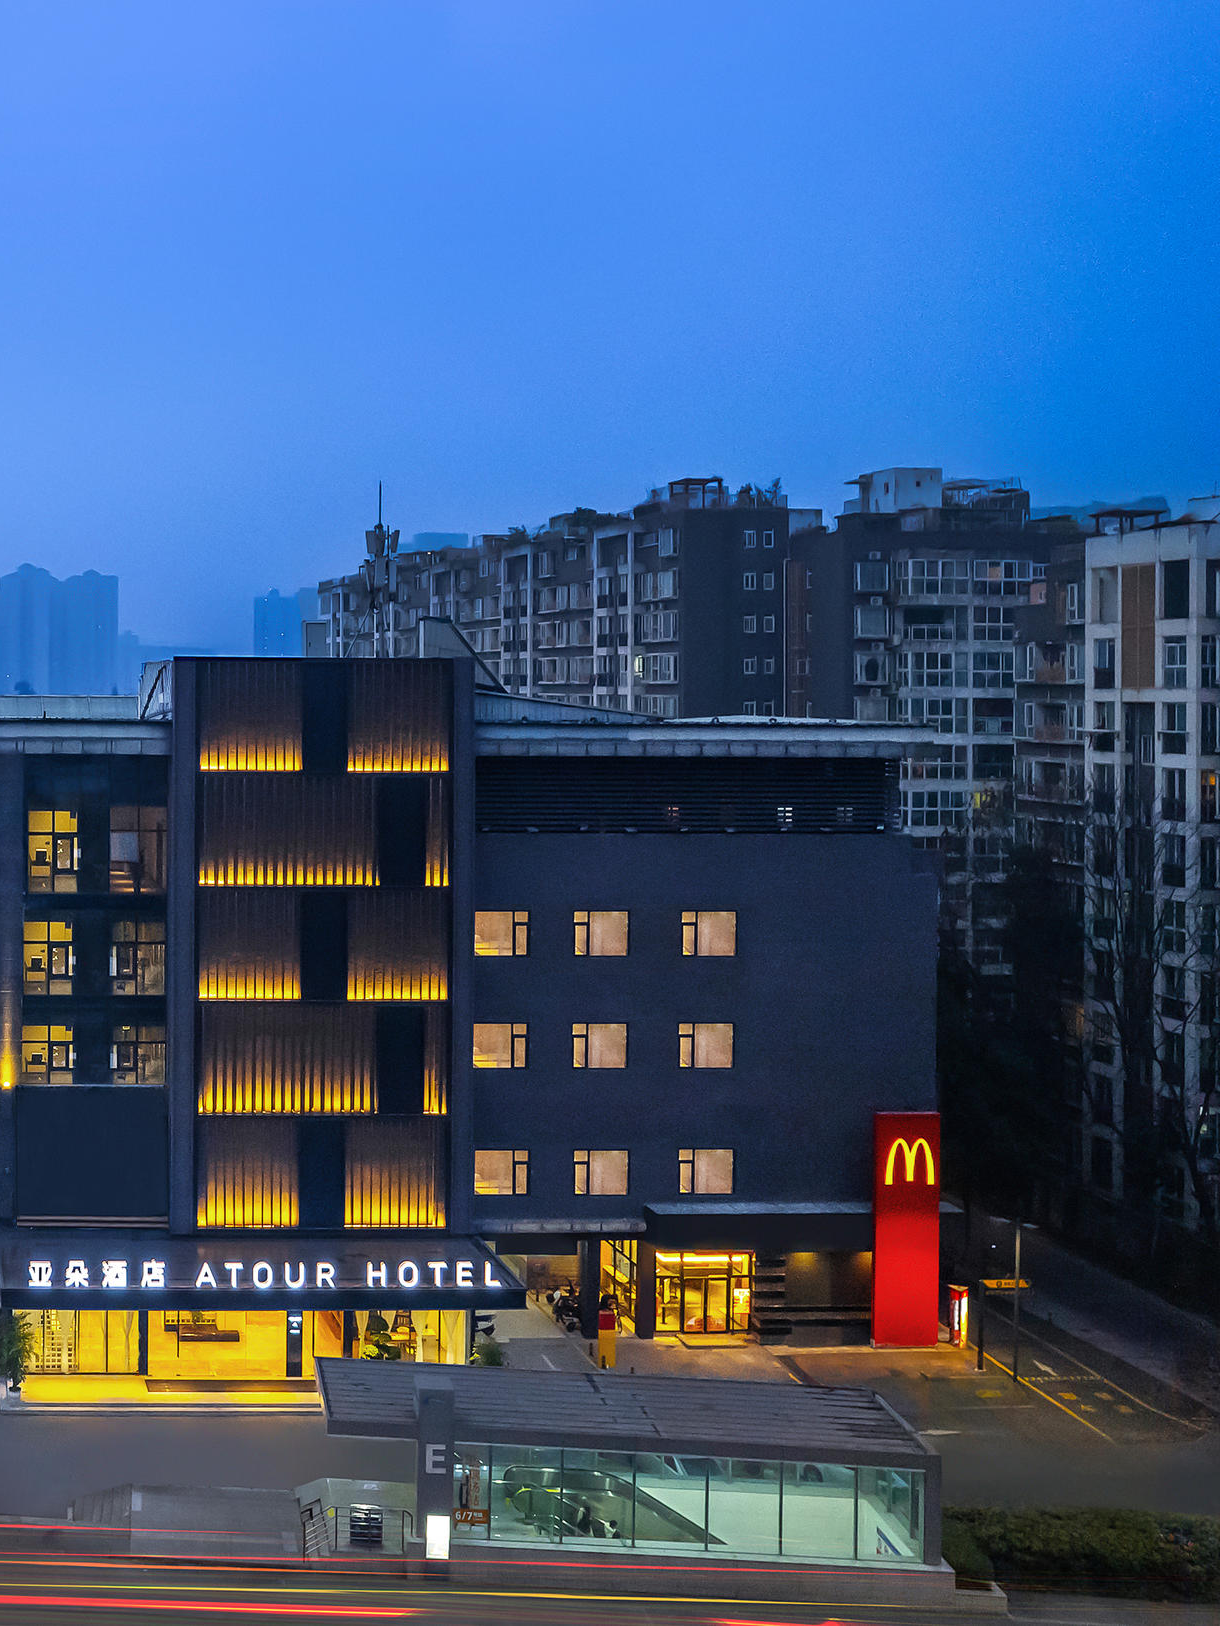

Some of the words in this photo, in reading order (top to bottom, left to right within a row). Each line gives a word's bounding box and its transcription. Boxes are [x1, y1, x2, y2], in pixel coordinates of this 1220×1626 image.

[28, 1259, 166, 1288] 亚朵酒店
[195, 1261, 335, 1288] ATOUR
[366, 1261, 502, 1288] HOTEL
[425, 1443, 446, 1474] E
